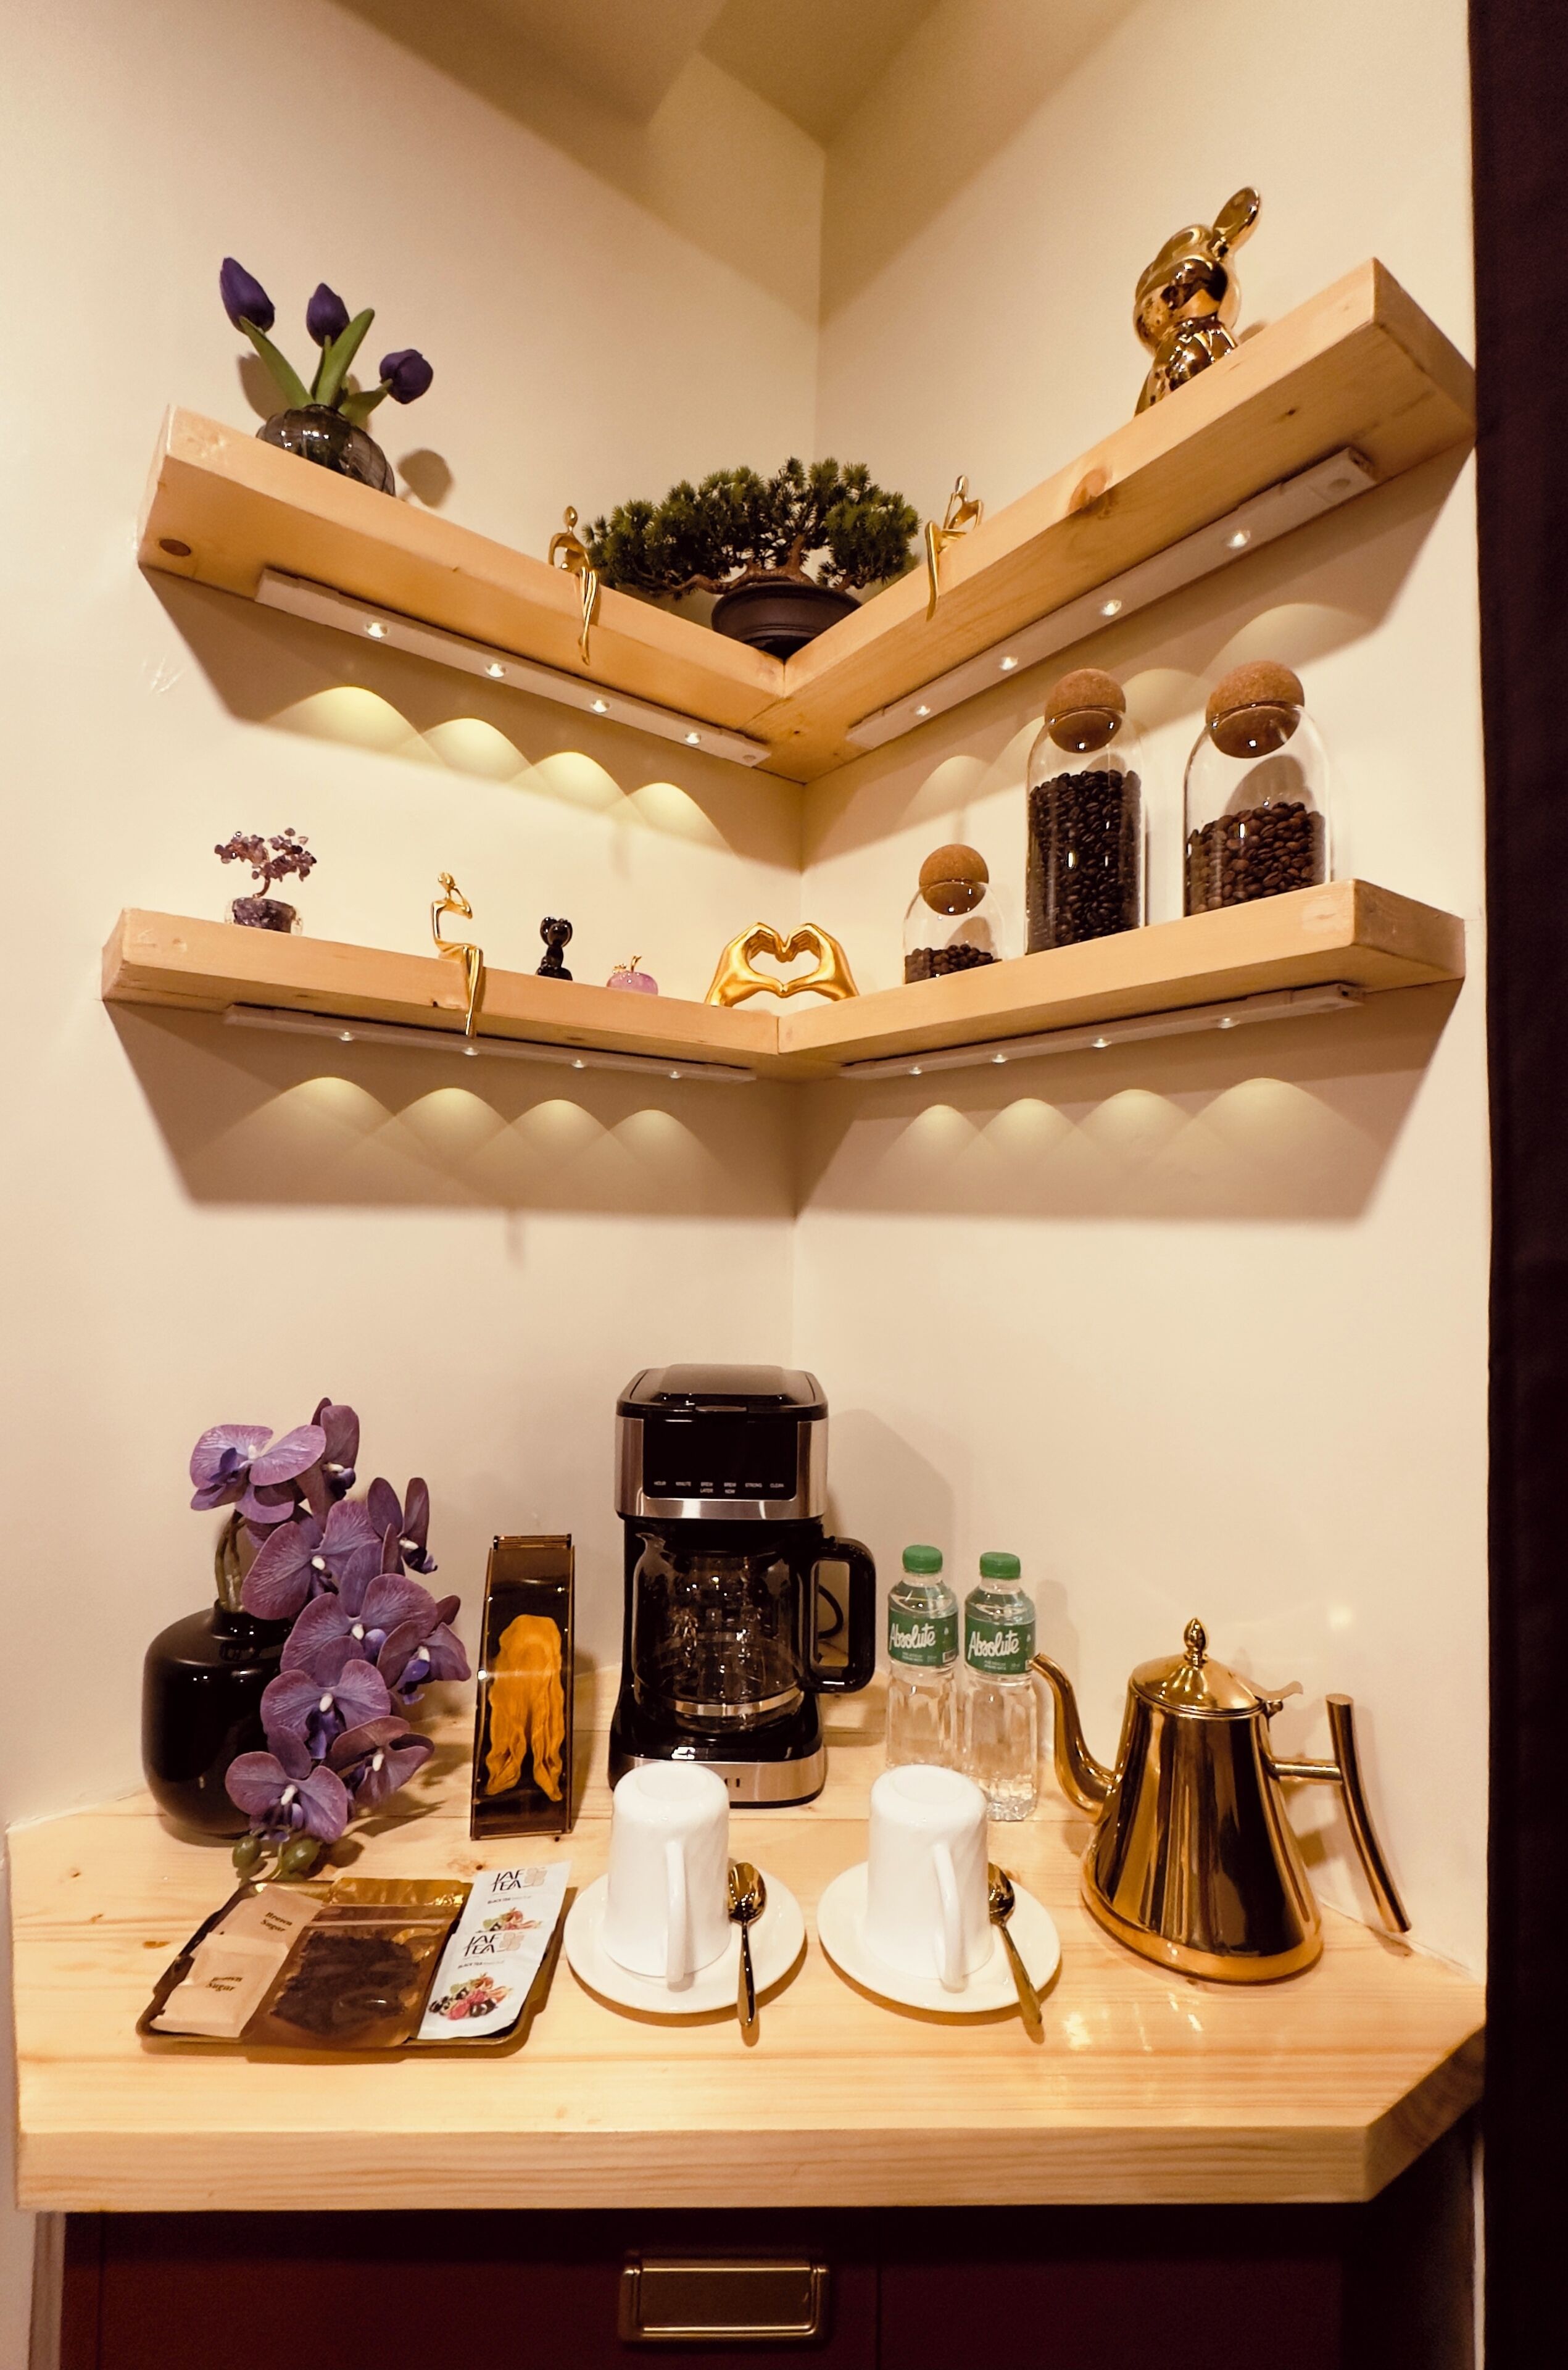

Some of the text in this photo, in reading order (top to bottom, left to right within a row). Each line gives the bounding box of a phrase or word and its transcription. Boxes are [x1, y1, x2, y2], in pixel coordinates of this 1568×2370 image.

[889, 1623, 936, 1650] Absolute
[968, 1630, 1020, 1660] Absolute
[265, 1912, 292, 1926] Brown
